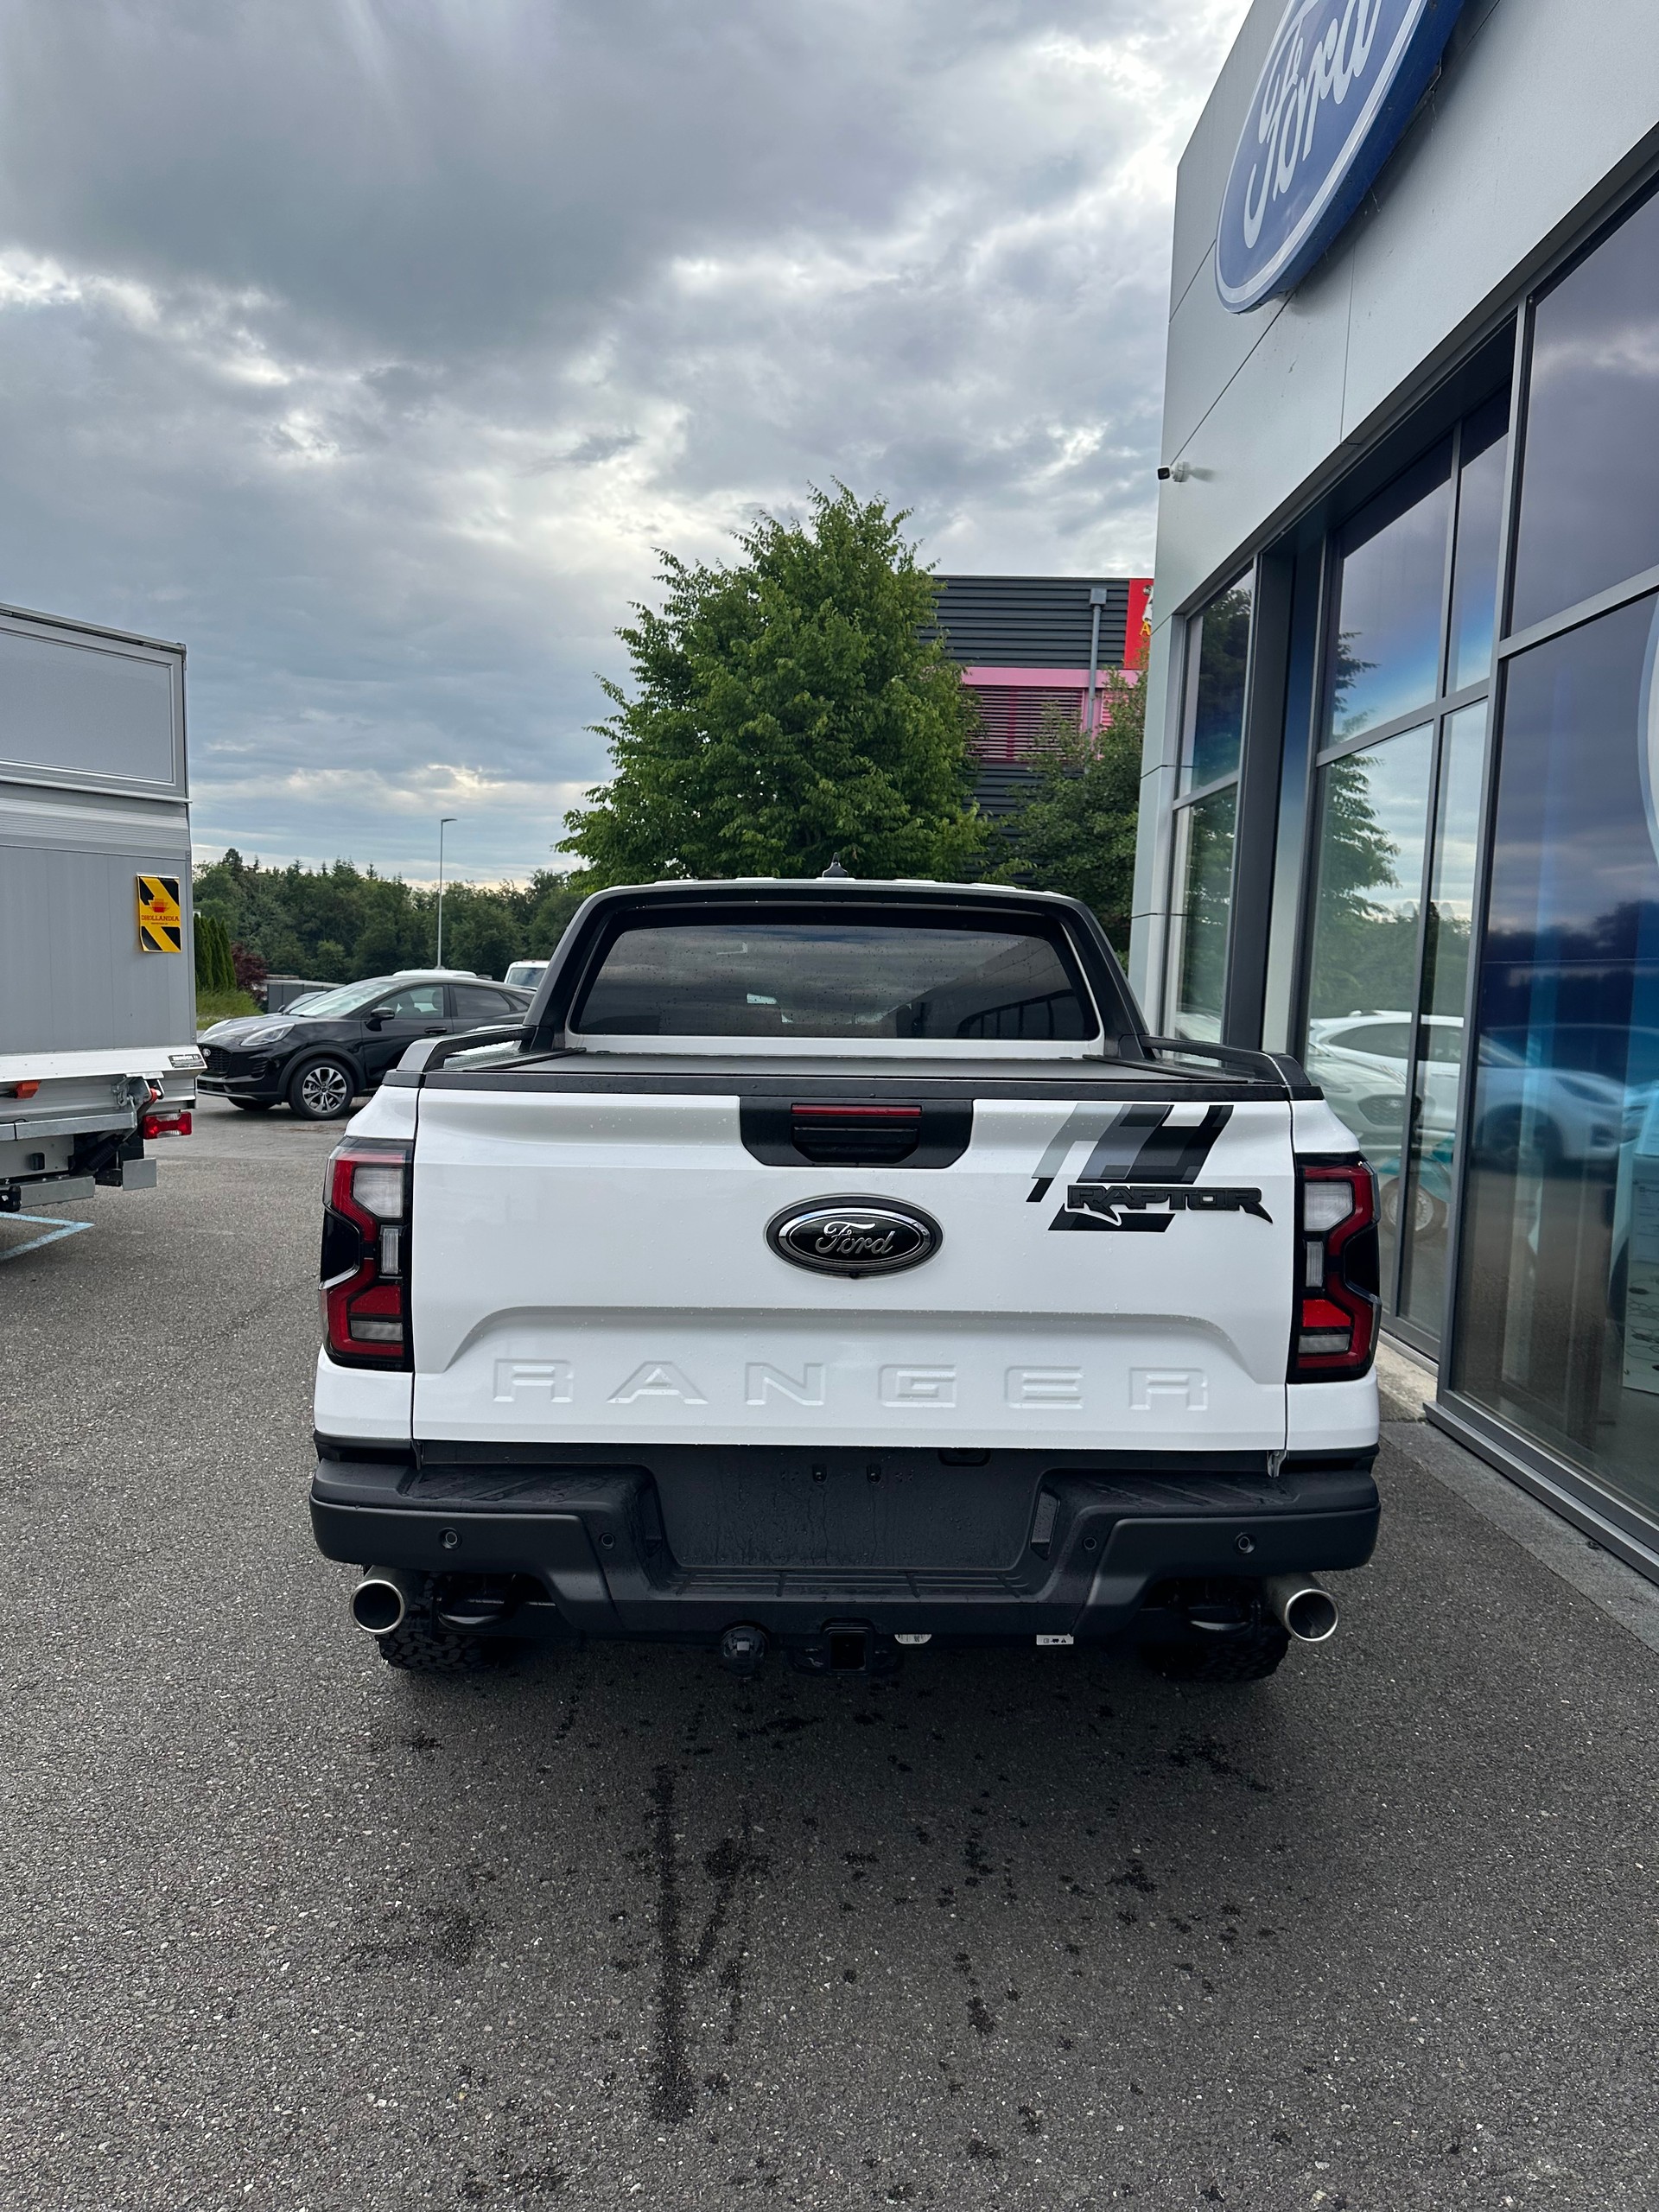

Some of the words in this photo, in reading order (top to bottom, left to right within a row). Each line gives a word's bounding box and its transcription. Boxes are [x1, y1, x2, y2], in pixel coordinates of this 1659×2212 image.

[1067, 1185, 1274, 1225] RAPTOR
[814, 1220, 896, 1255] Ford
[493, 1358, 1209, 1411] RANGER
